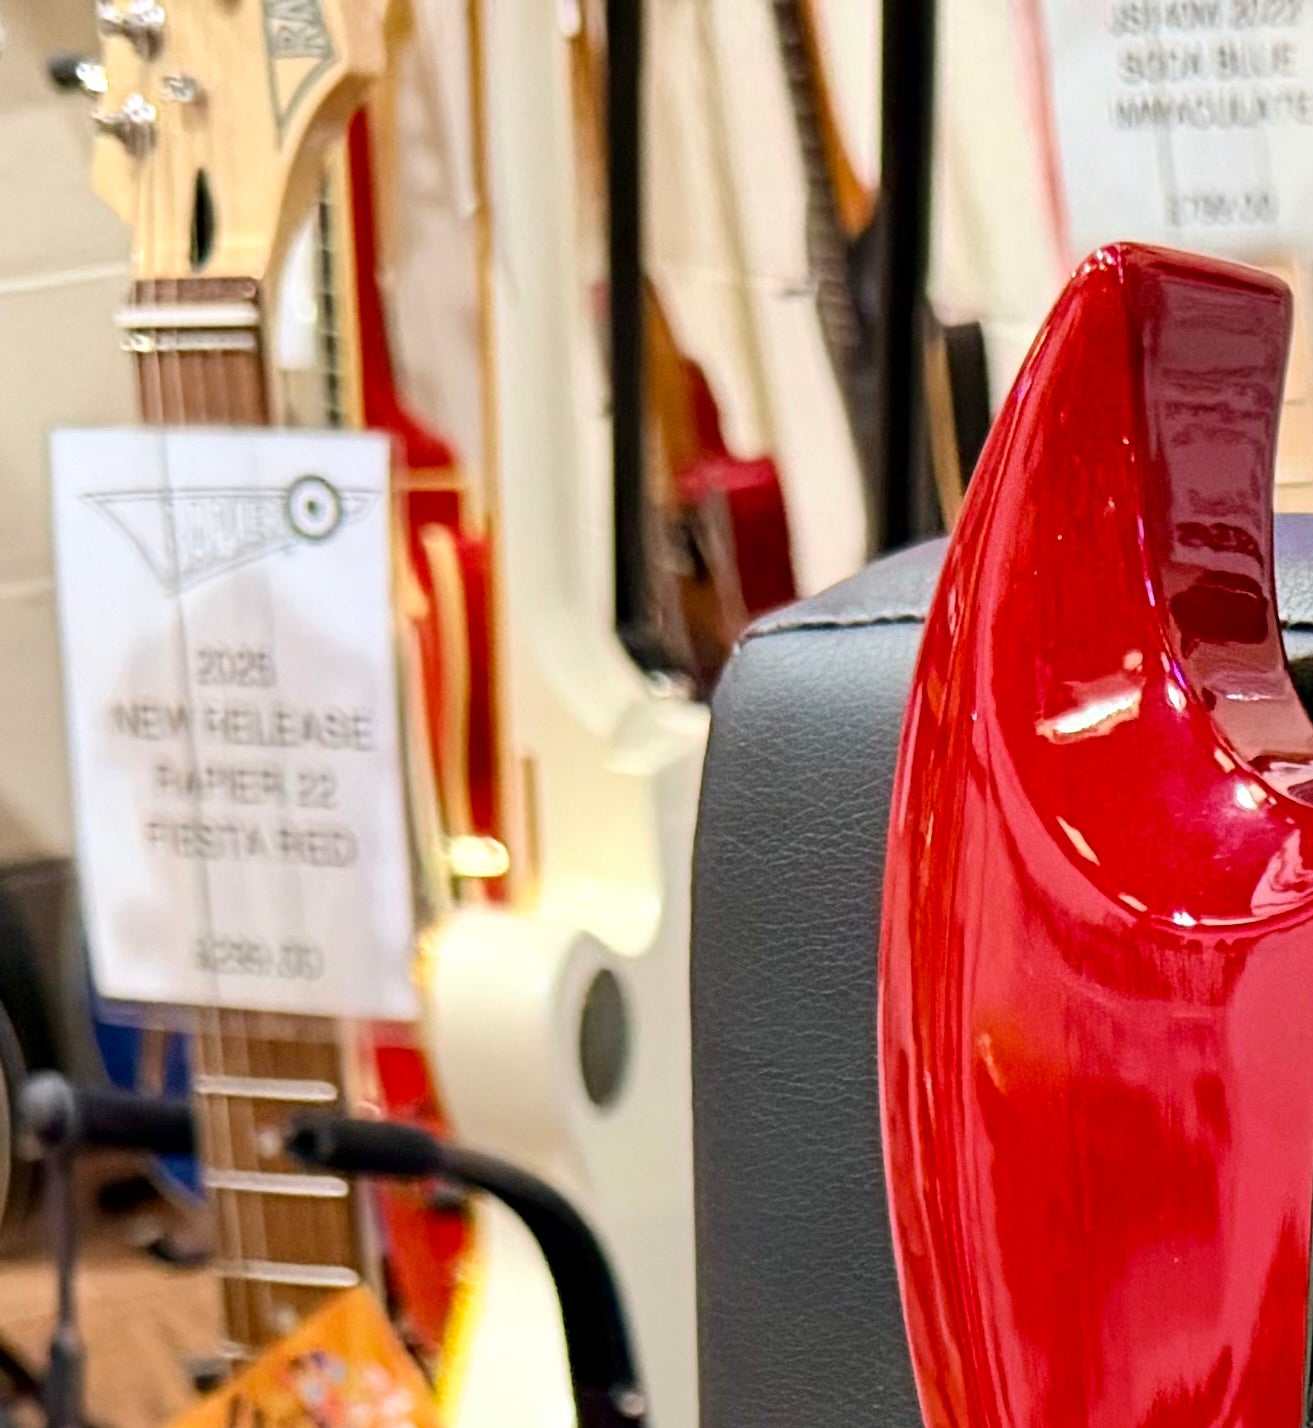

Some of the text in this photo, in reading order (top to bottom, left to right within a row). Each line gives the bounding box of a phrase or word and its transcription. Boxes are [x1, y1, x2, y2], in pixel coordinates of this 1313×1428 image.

[113, 704, 376, 752] NEW RELEASE
[279, 829, 359, 868] RED
